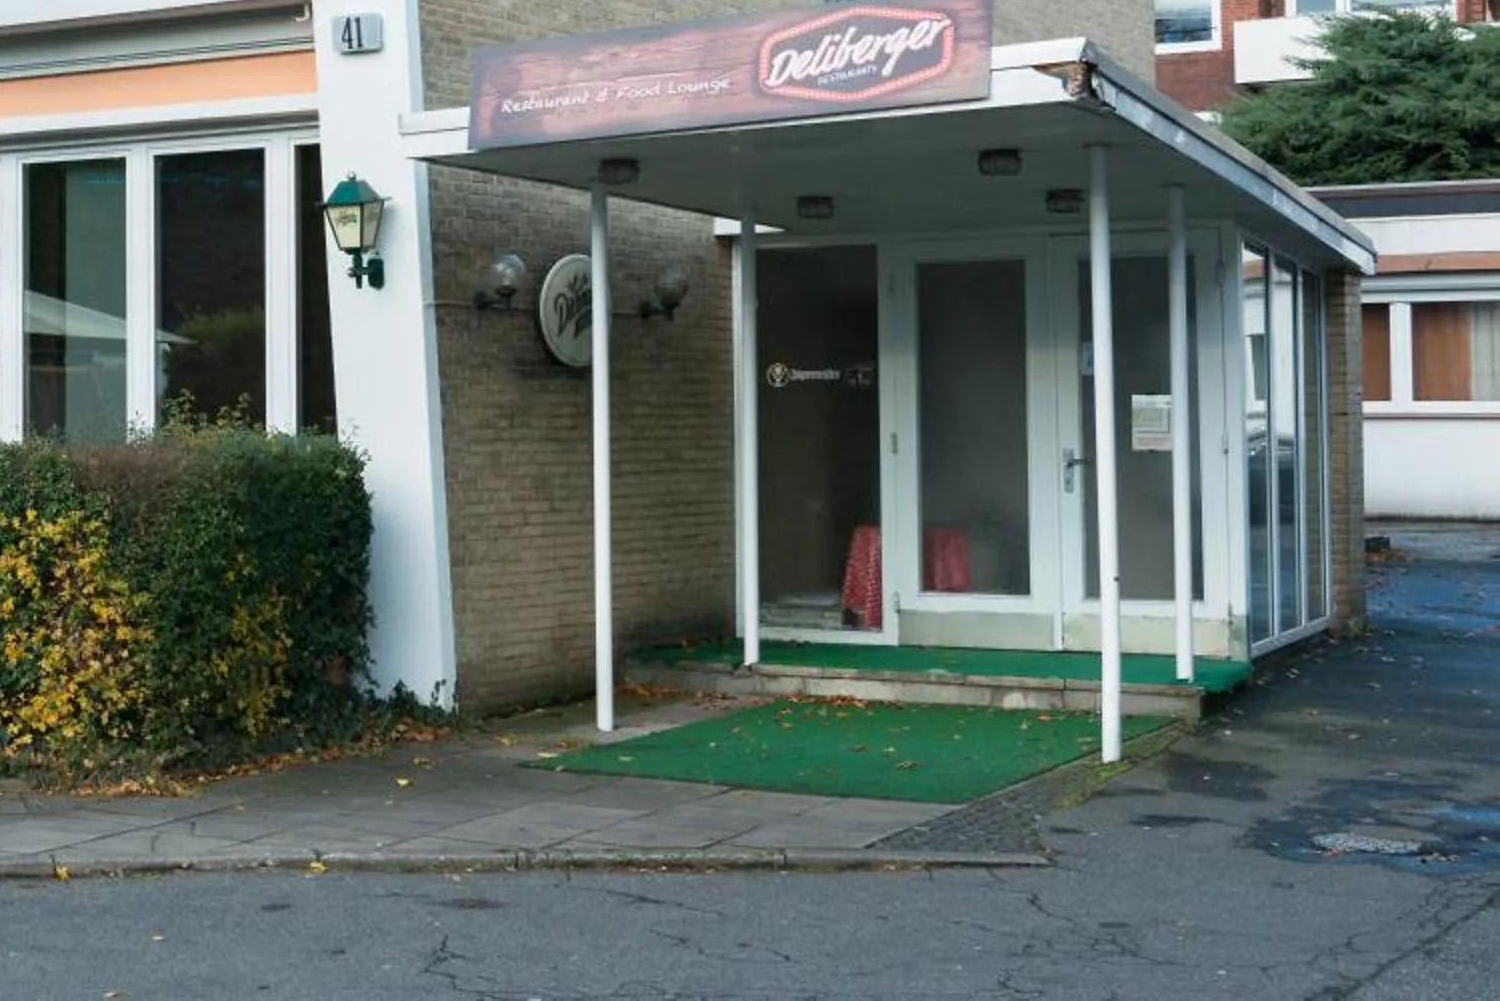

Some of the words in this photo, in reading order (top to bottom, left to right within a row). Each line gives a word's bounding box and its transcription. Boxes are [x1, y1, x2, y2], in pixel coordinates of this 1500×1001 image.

[341, 16, 364, 49] 41
[766, 19, 951, 87] Deliberger
[501, 90, 590, 114] Restaurant
[616, 78, 661, 99] Food
[668, 74, 731, 95] Lounge
